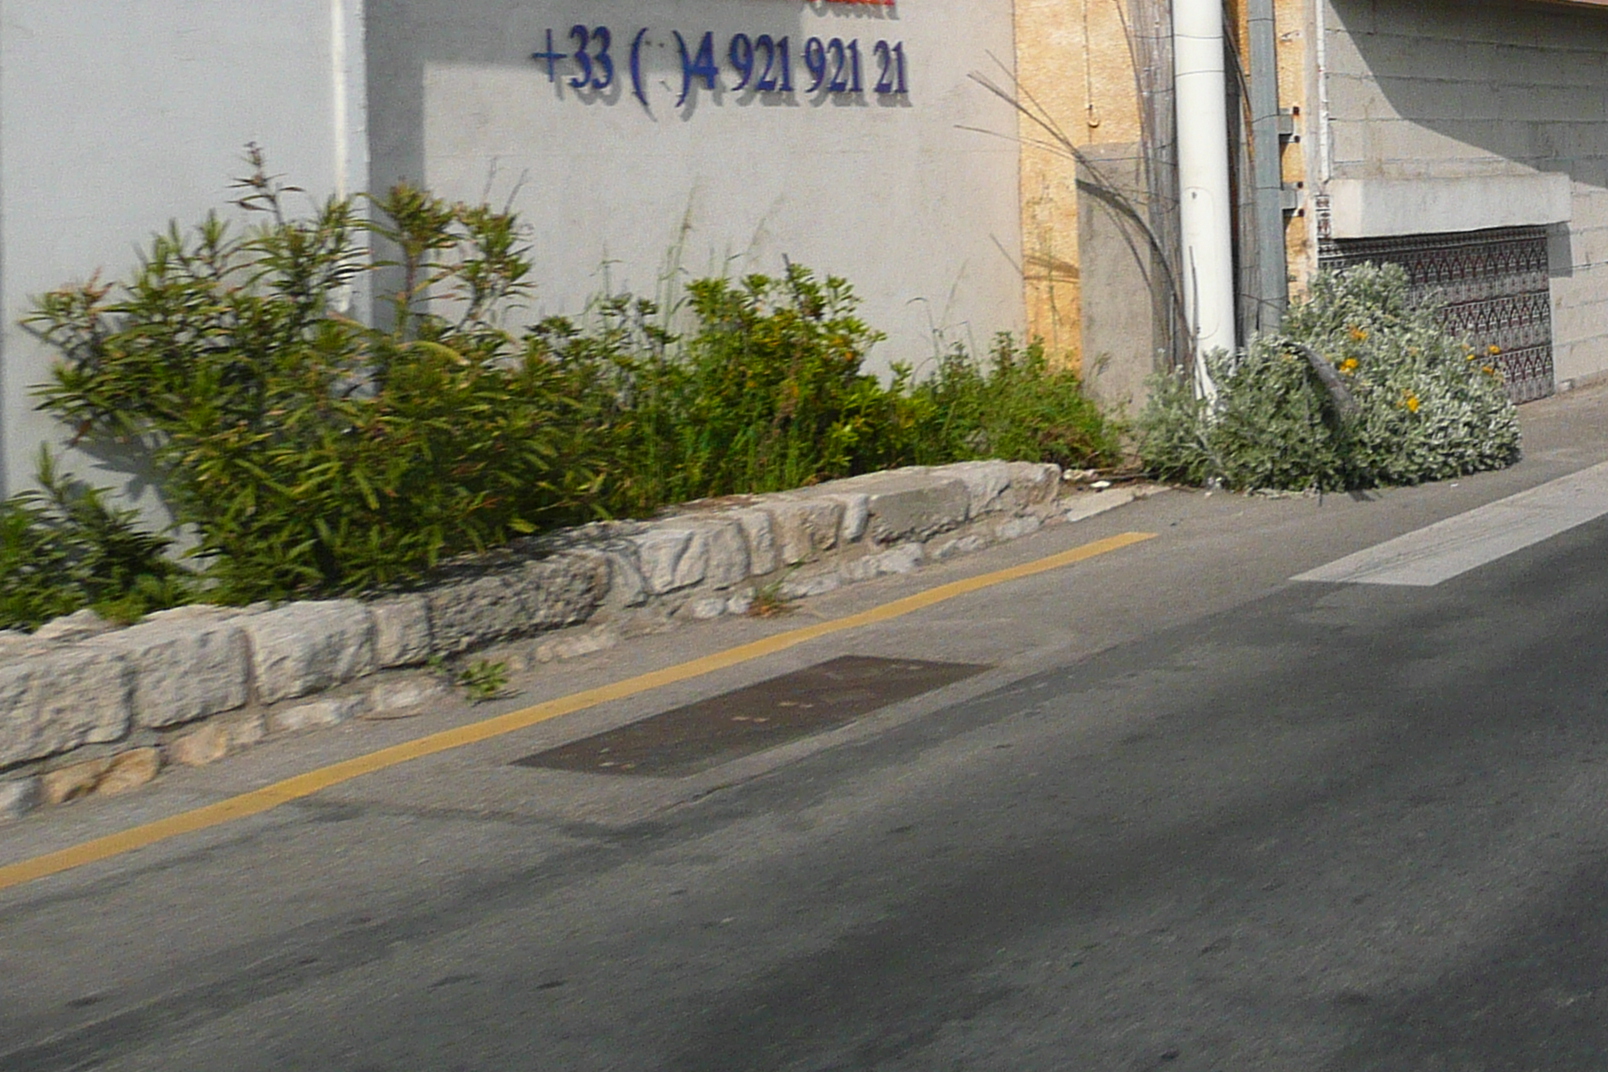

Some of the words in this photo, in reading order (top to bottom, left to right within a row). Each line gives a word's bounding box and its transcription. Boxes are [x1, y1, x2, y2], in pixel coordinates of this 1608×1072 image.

[532, 24, 615, 90] +33
[729, 32, 794, 93] 921
[804, 36, 864, 94] 921
[873, 39, 908, 94] 21
